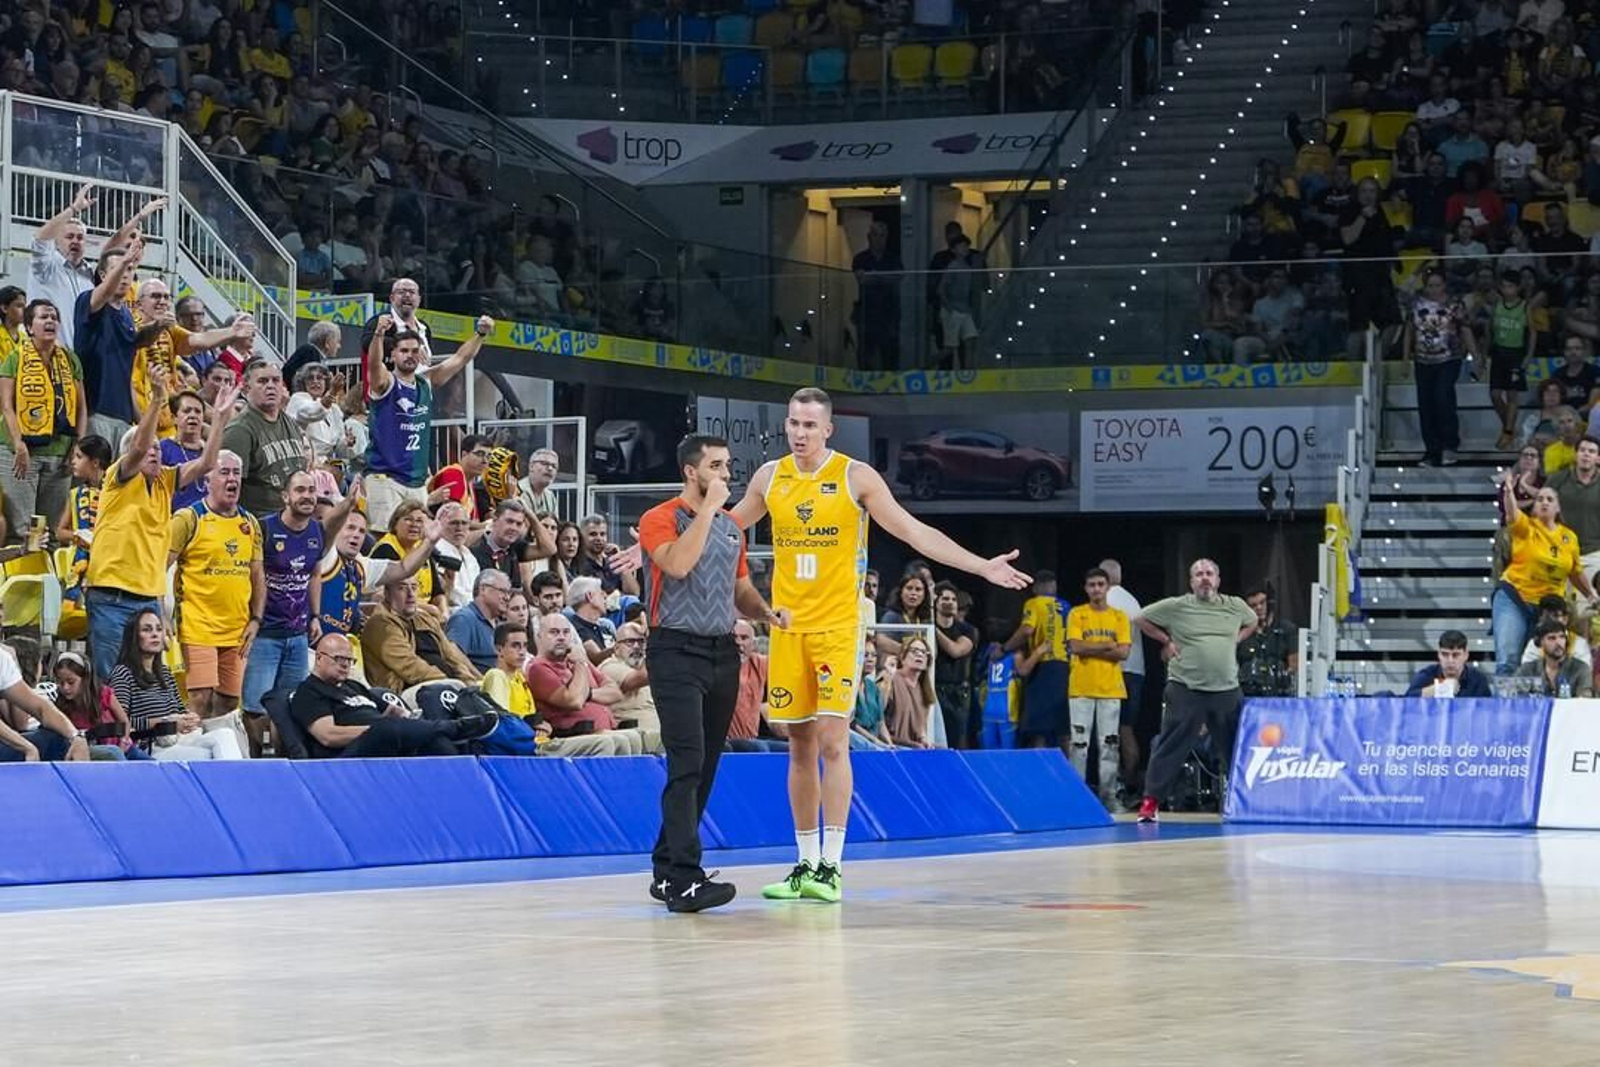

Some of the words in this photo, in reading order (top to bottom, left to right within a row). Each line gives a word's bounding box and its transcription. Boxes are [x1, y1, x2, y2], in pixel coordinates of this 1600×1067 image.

[624, 130, 682, 166] trop
[821, 141, 893, 159] trop
[985, 133, 1061, 152] trop
[705, 416, 756, 446] TOYOTA
[1093, 418, 1182, 439] TOYOTA
[405, 434, 420, 451] 22
[1093, 442, 1148, 462] EASY
[795, 553, 818, 580] 10
[991, 663, 1004, 683] 12
[1363, 741, 1381, 756] Tu
[1386, 742, 1452, 760] agencia
[1457, 742, 1479, 757] de
[1483, 742, 1531, 761] viajes
[1245, 747, 1346, 791] Insular
[1358, 763, 1379, 776] en
[1385, 761, 1408, 776] las
[1412, 761, 1449, 777] Islas
[1455, 760, 1530, 778] Canarias
